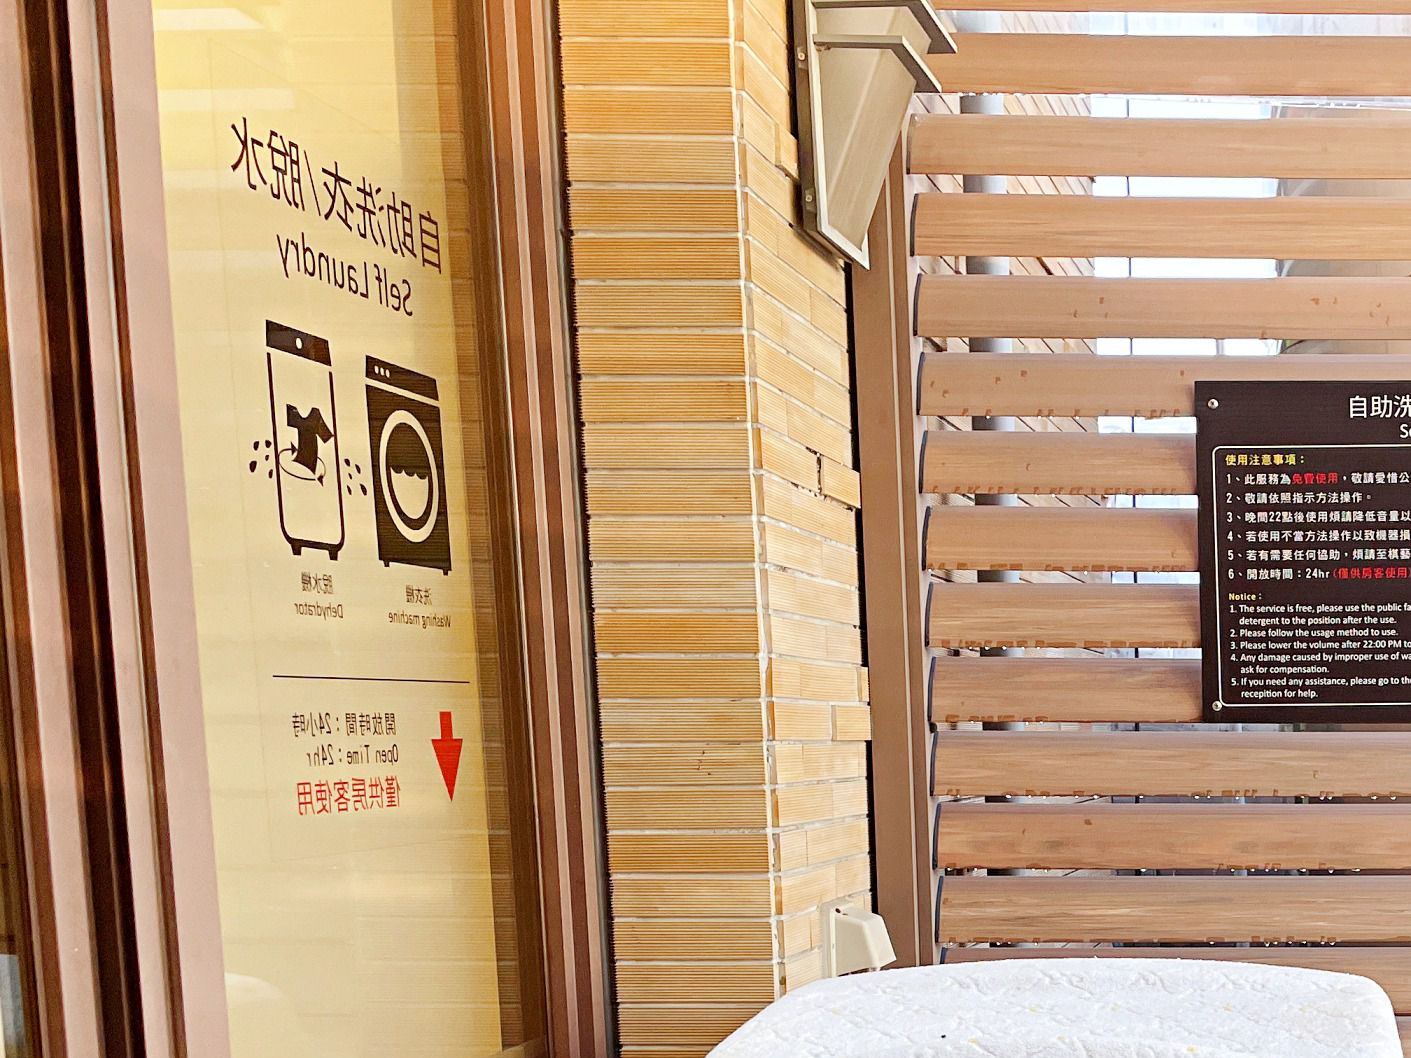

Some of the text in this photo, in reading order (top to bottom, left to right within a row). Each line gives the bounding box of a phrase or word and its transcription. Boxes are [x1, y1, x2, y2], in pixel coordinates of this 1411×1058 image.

[1230, 604, 1237, 614] 1.
[1239, 604, 1254, 613] The
[1257, 604, 1285, 613] service
[1287, 603, 1294, 613] is
[1296, 603, 1314, 614] free,
[1317, 603, 1343, 614] please
[1345, 604, 1359, 612] use
[1361, 603, 1375, 612] the
[1377, 602, 1402, 614] public
[1239, 615, 1396, 628] detergent to the position after the use.
[1230, 627, 1398, 639] 2. Please follow the usage method to use.
[1231, 640, 1239, 650] 3.
[1240, 640, 1266, 650] Please
[1269, 640, 1292, 650] lower
[1294, 640, 1307, 650] the
[1310, 639, 1339, 649] volume
[1342, 639, 1361, 649] after
[1363, 639, 1386, 649] 22:00
[1388, 639, 1401, 649] PM
[1404, 640, 1411, 648] to
[1231, 653, 1238, 662] 4.
[1240, 653, 1256, 664] Any
[1258, 652, 1290, 664] damage
[1292, 652, 1320, 662] caused
[1323, 652, 1333, 663] by
[1335, 652, 1372, 663] improper
[1375, 653, 1389, 661] use
[1391, 651, 1399, 661] of
[1241, 664, 1329, 675] ask for compensation.
[1232, 677, 1239, 686] 5.
[1241, 677, 1247, 686] If
[1249, 679, 1264, 688] you
[1266, 676, 1286, 686] need
[1288, 678, 1303, 687] any
[1305, 676, 1348, 686] assistance,
[1351, 676, 1376, 687] please
[1378, 677, 1389, 687] go
[1391, 676, 1399, 685] to
[1284, 688, 1296, 698] for
[1298, 688, 1318, 700] help.
